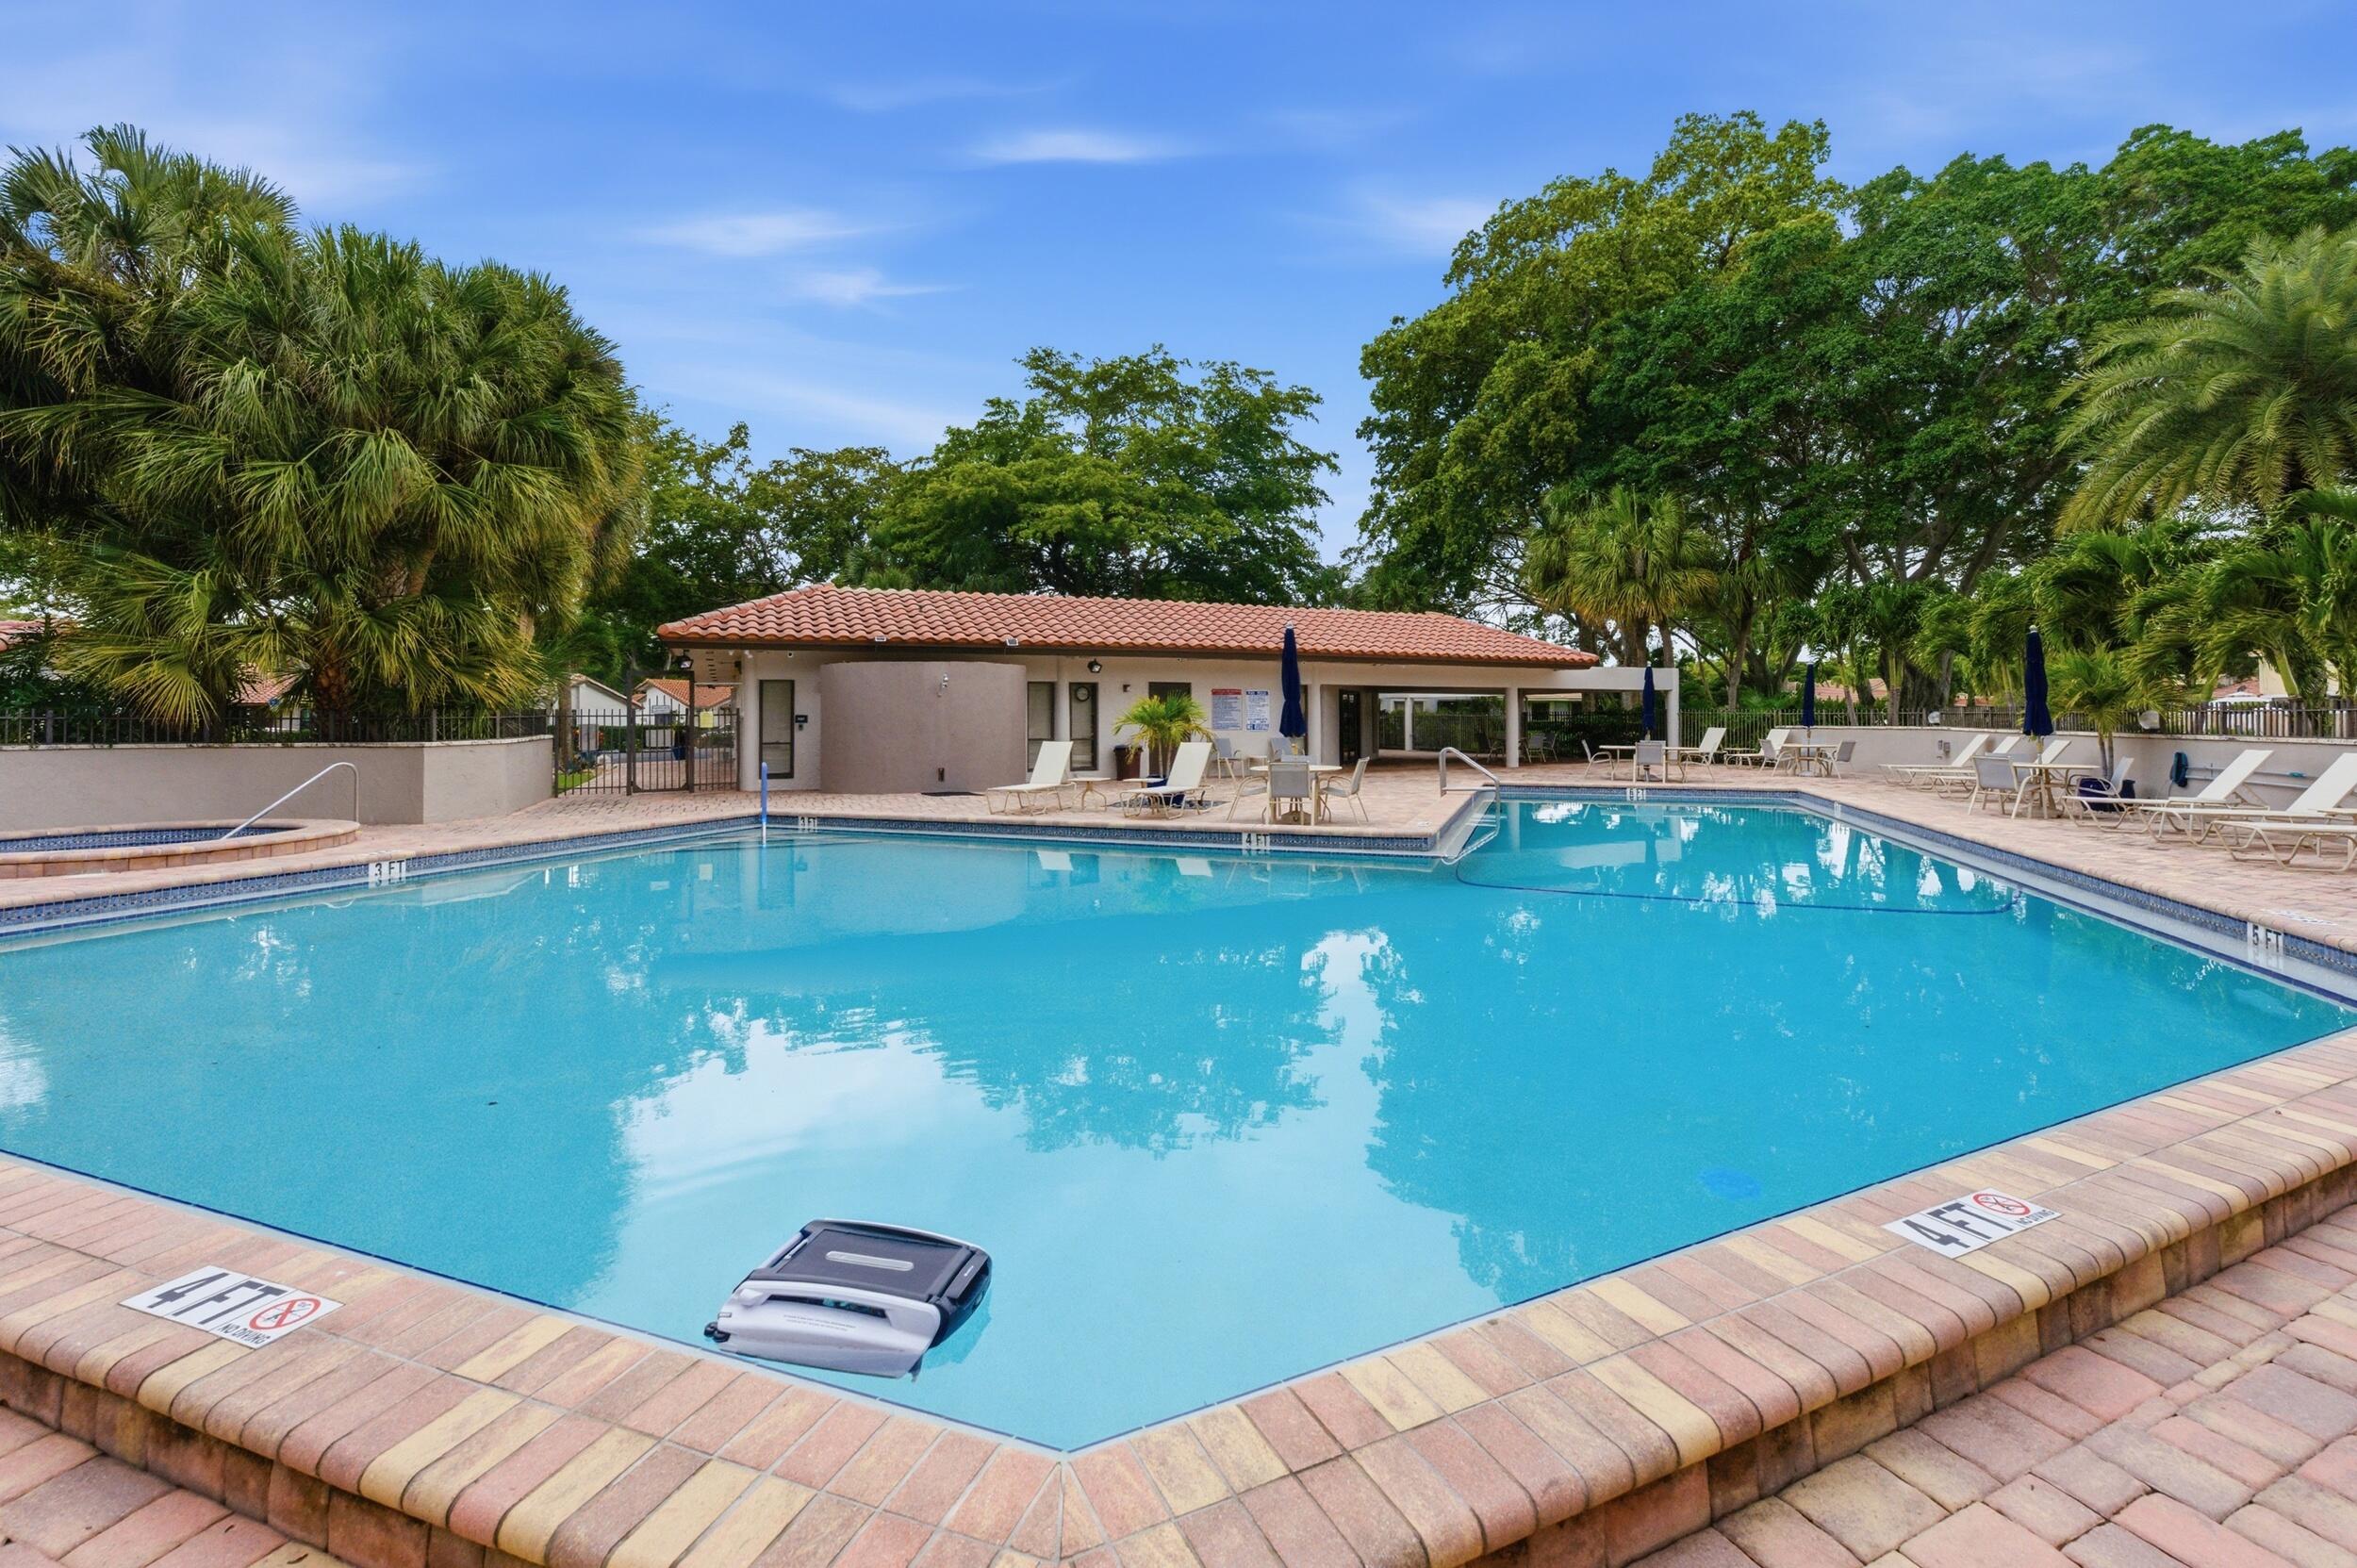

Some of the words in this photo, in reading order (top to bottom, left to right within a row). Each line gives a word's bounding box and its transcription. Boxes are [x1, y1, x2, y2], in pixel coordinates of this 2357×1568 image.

[1245, 833, 1252, 846] 4
[1256, 834, 1268, 847] FT
[375, 863, 382, 880] 3
[388, 860, 405, 878] FT
[2252, 924, 2259, 946] 5
[2265, 929, 2282, 953] FT
[1903, 1219, 1971, 1249] 4
[1926, 1202, 2014, 1240] FT
[147, 1272, 230, 1309] 4
[172, 1280, 288, 1325] FT
[218, 1323, 240, 1334] NO
[232, 1328, 272, 1345] DIVING
